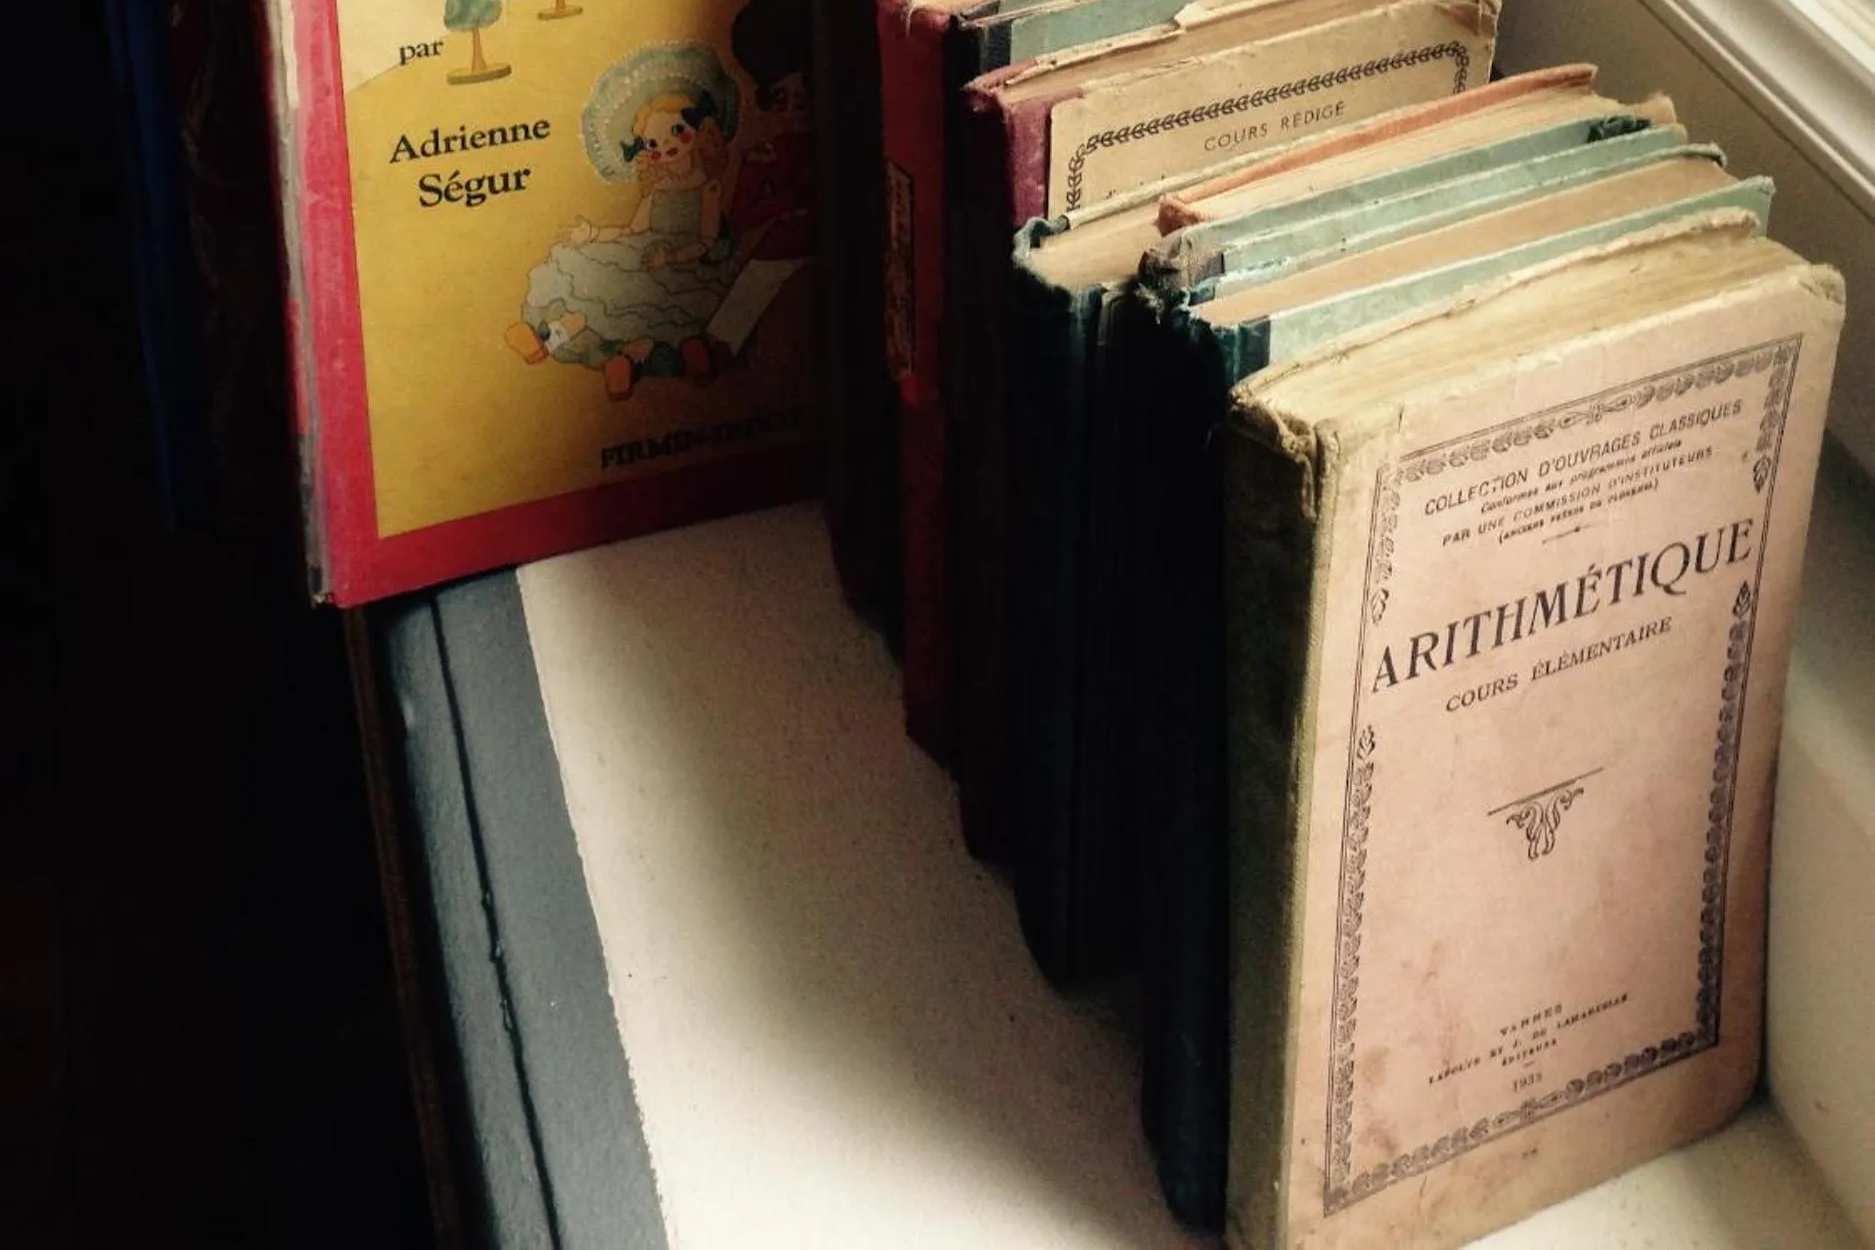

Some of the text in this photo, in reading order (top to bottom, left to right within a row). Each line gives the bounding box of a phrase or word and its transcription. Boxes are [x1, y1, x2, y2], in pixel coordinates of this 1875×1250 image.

[399, 39, 444, 66] par
[389, 117, 551, 164] Adrienne
[1204, 122, 1268, 152] COURS
[417, 164, 532, 209] Ségur
[1424, 398, 1743, 516] COLLECTION D'OUVRAGES CLASSIQUES
[1442, 528, 1471, 547] PAR
[1478, 517, 1505, 535] UNE
[1513, 483, 1601, 522] COMMISSION
[1371, 517, 1755, 694] ARITHMÉTIQUE
[1445, 615, 1673, 713] COURS ÉLÉMENTAIRE
